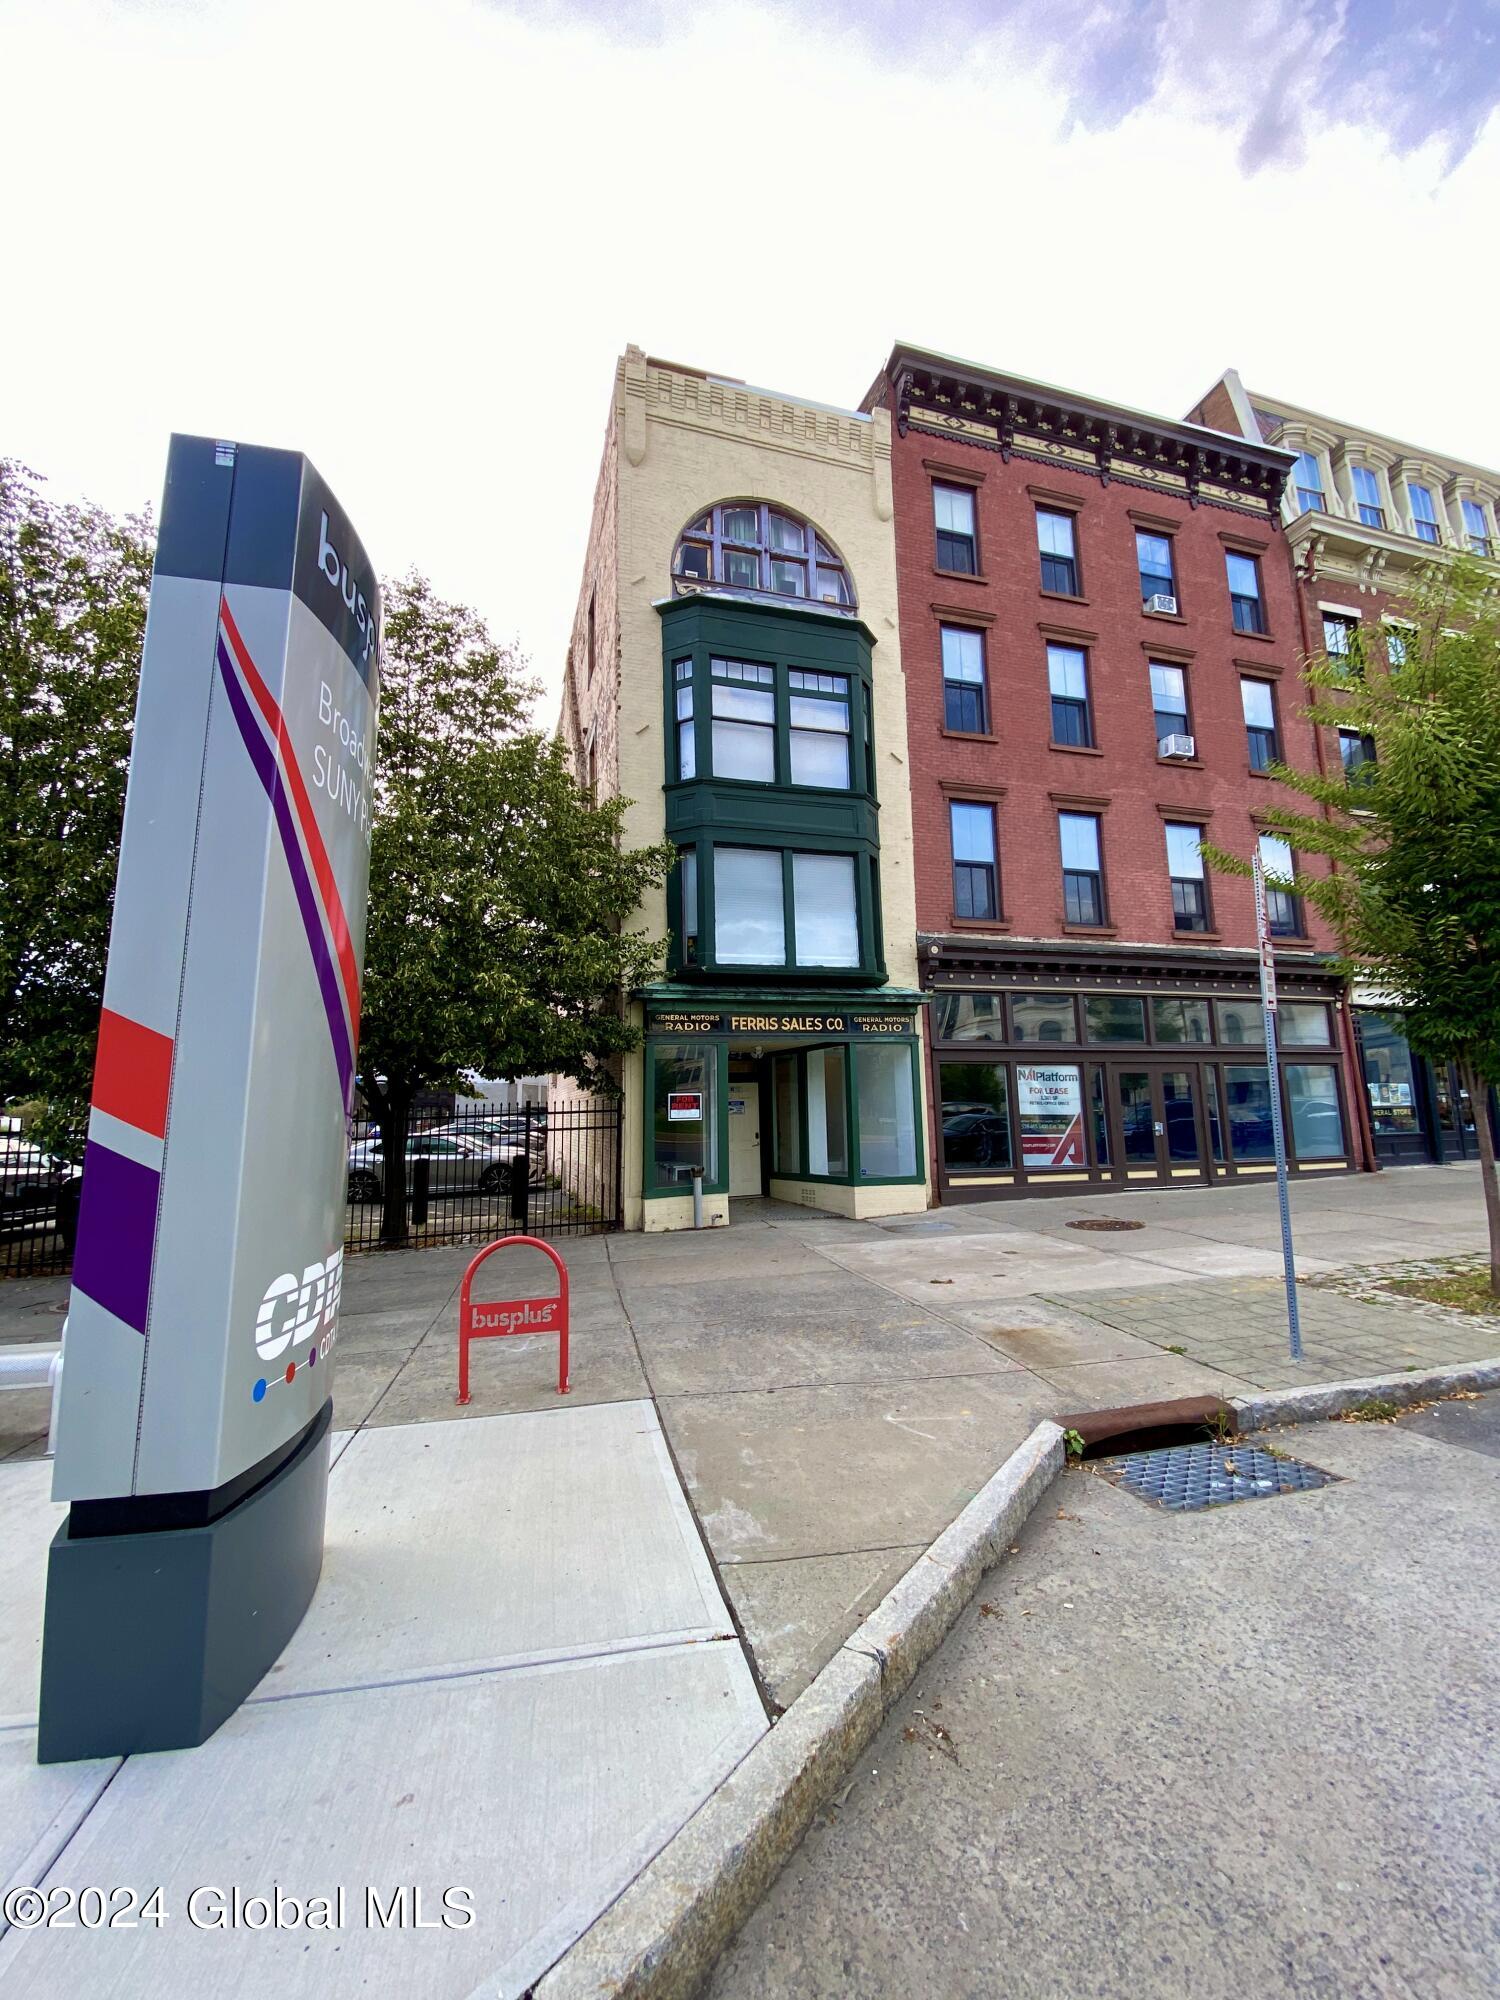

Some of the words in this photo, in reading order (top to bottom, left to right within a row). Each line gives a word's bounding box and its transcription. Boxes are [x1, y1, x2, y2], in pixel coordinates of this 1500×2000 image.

[312, 744, 361, 823] SUNY
[665, 1022, 711, 1031] RADIO
[731, 1016, 779, 1031] FERRIS
[781, 1017, 823, 1031] SALES
[826, 1017, 845, 1031] CO.
[862, 1024, 902, 1032] RADIO
[1045, 1087, 1069, 1095] LEASE
